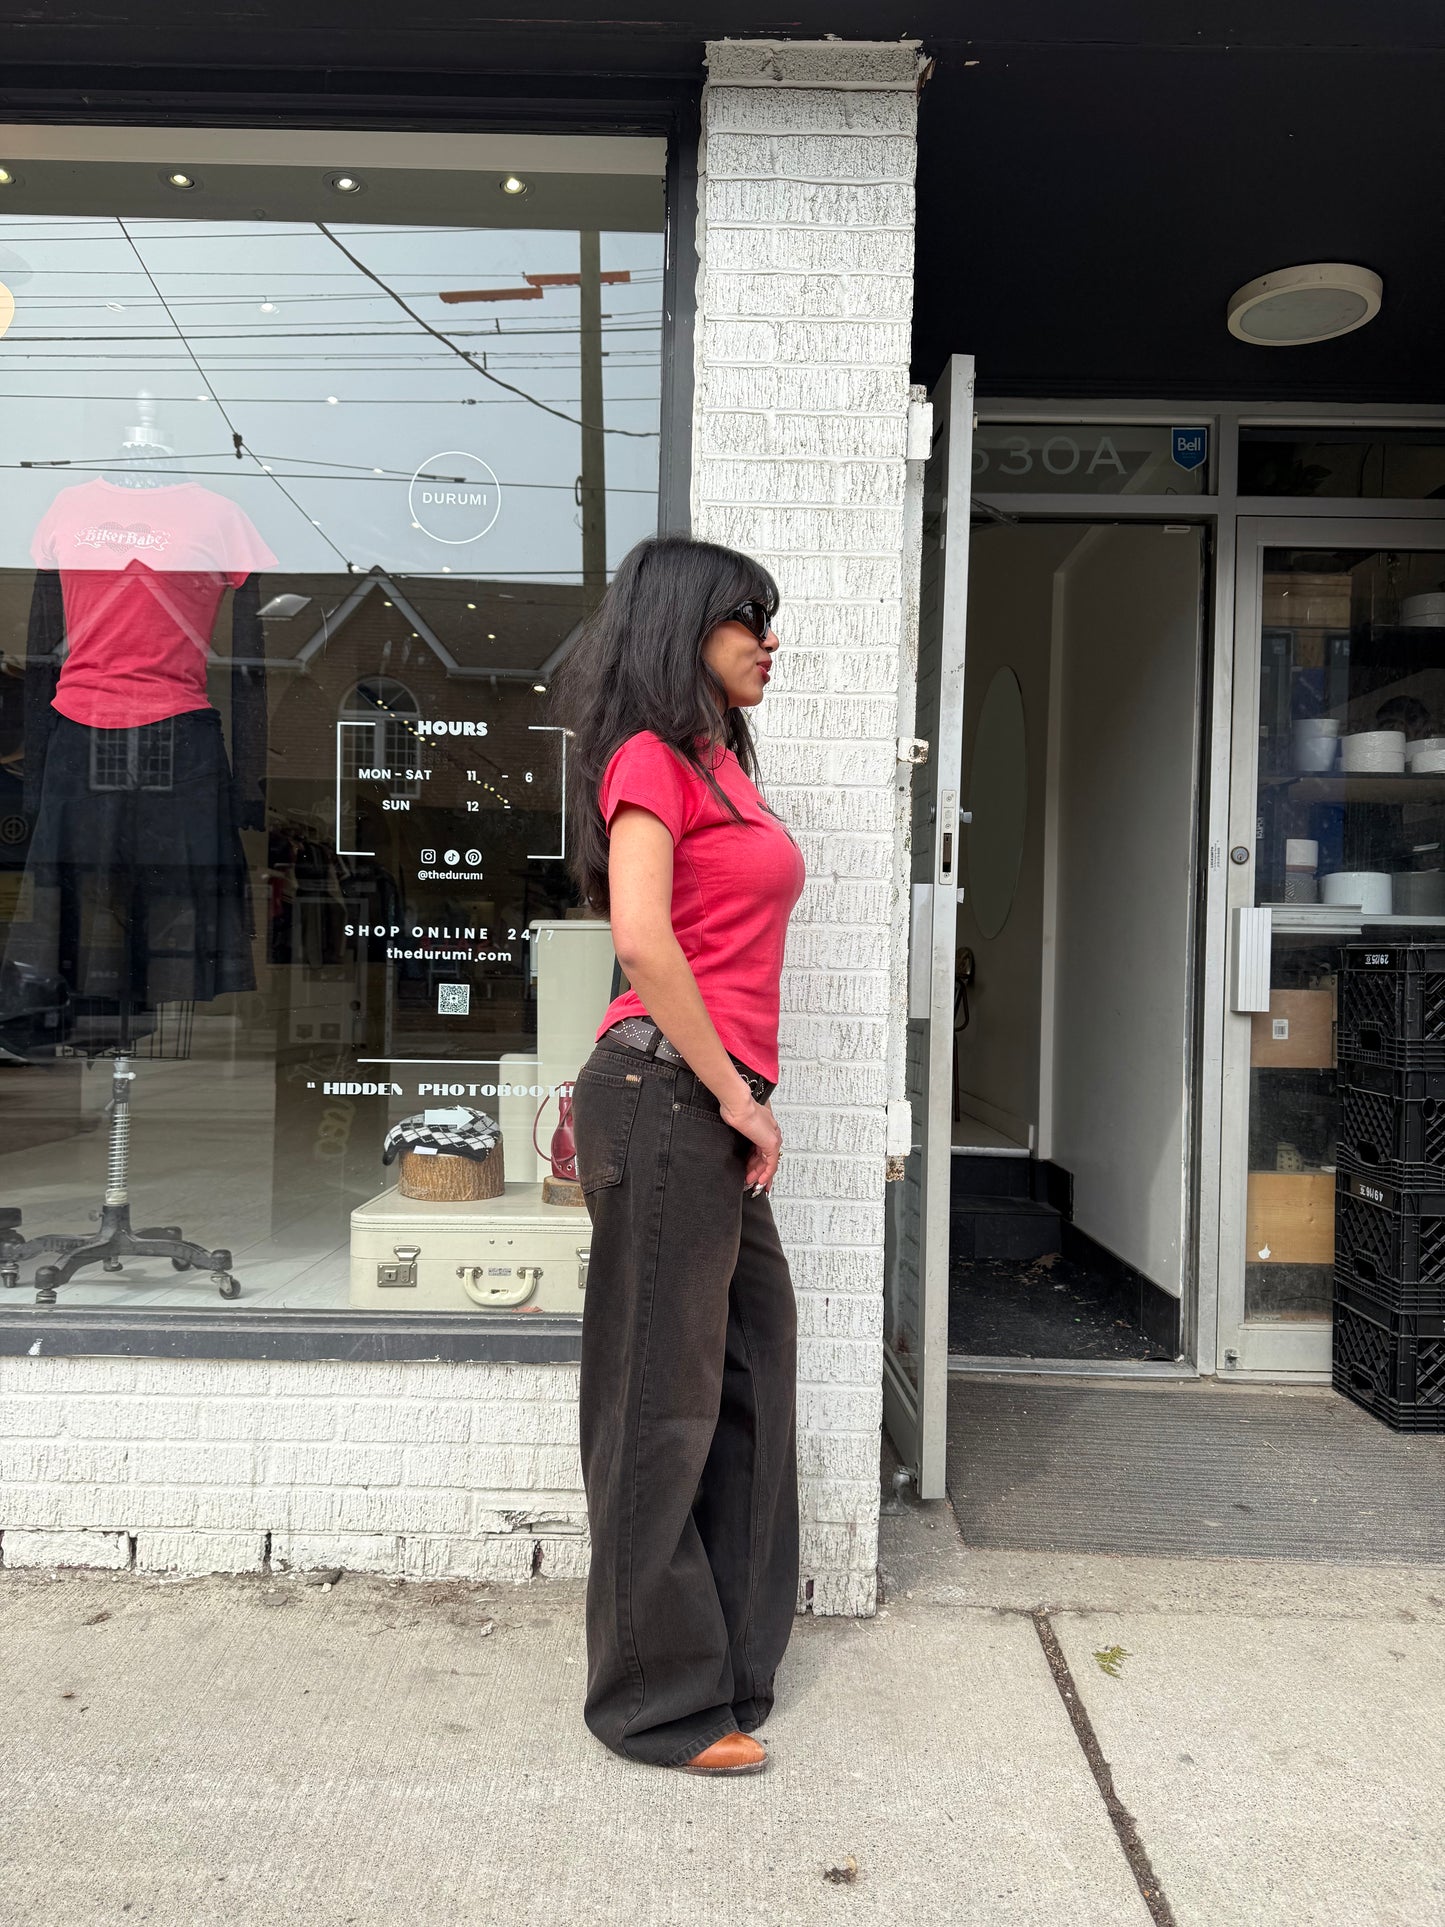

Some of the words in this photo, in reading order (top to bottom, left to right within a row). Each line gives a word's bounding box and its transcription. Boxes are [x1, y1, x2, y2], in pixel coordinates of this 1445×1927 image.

[1177, 437, 1201, 451] Bell
[422, 492, 487, 505] DURUMI
[417, 720, 488, 737] HOURS
[358, 768, 391, 780] MON
[405, 769, 432, 780] SAT
[466, 770, 477, 781] 11
[525, 772, 533, 783] 6
[382, 799, 410, 811] SUN
[466, 801, 479, 812] 12
[344, 925, 400, 938] SHOP
[411, 926, 488, 940] ONLINE
[507, 926, 554, 943] 24/7
[386, 947, 512, 962] thedurumi.com
[323, 1082, 403, 1096] HIDDEN
[418, 1083, 574, 1097] PHOTOBOOTH
